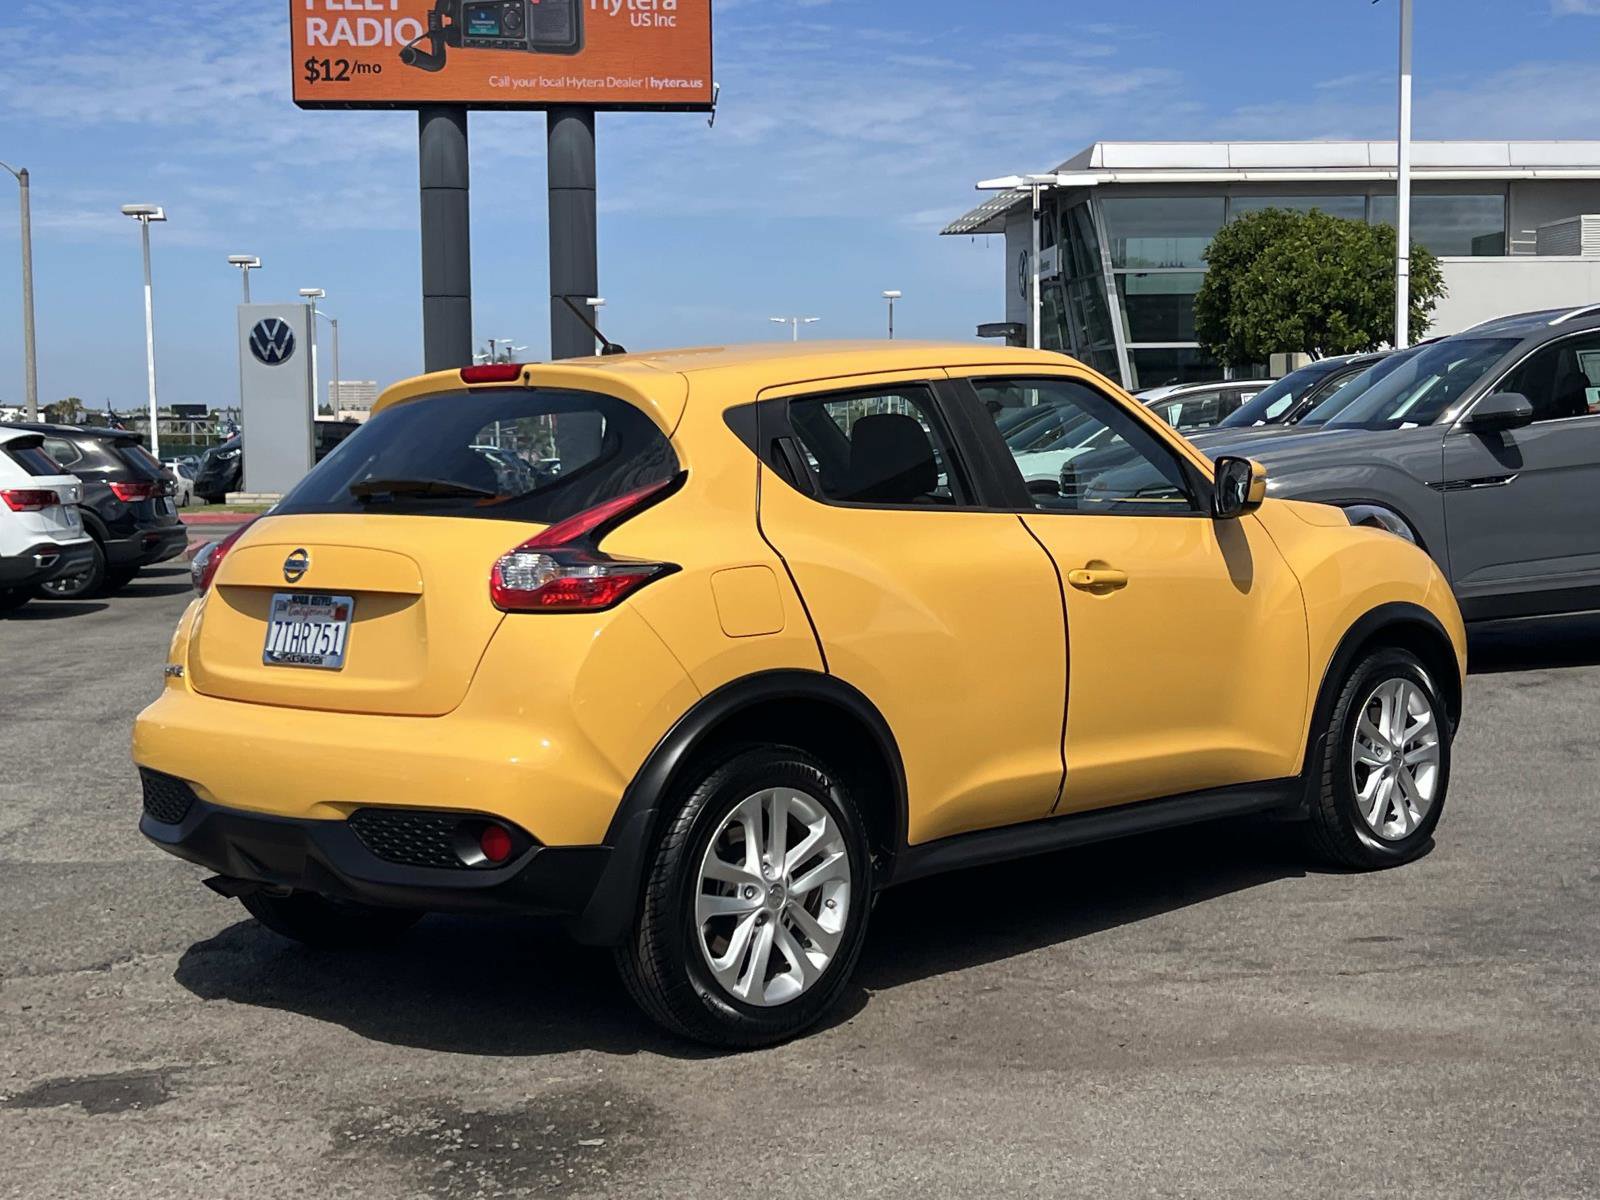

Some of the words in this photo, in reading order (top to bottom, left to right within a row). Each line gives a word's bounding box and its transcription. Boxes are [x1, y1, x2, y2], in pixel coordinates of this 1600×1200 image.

[630, 13, 651, 27] US
[654, 13, 677, 27] Inc
[306, 17, 423, 47] RADIO
[489, 75, 510, 88] Call
[511, 78, 537, 90] your
[539, 76, 564, 88] local
[566, 76, 604, 89] Hytera
[606, 76, 643, 88] Dealer
[650, 76, 703, 90] hytera.us
[272, 621, 341, 656] 7THR751
